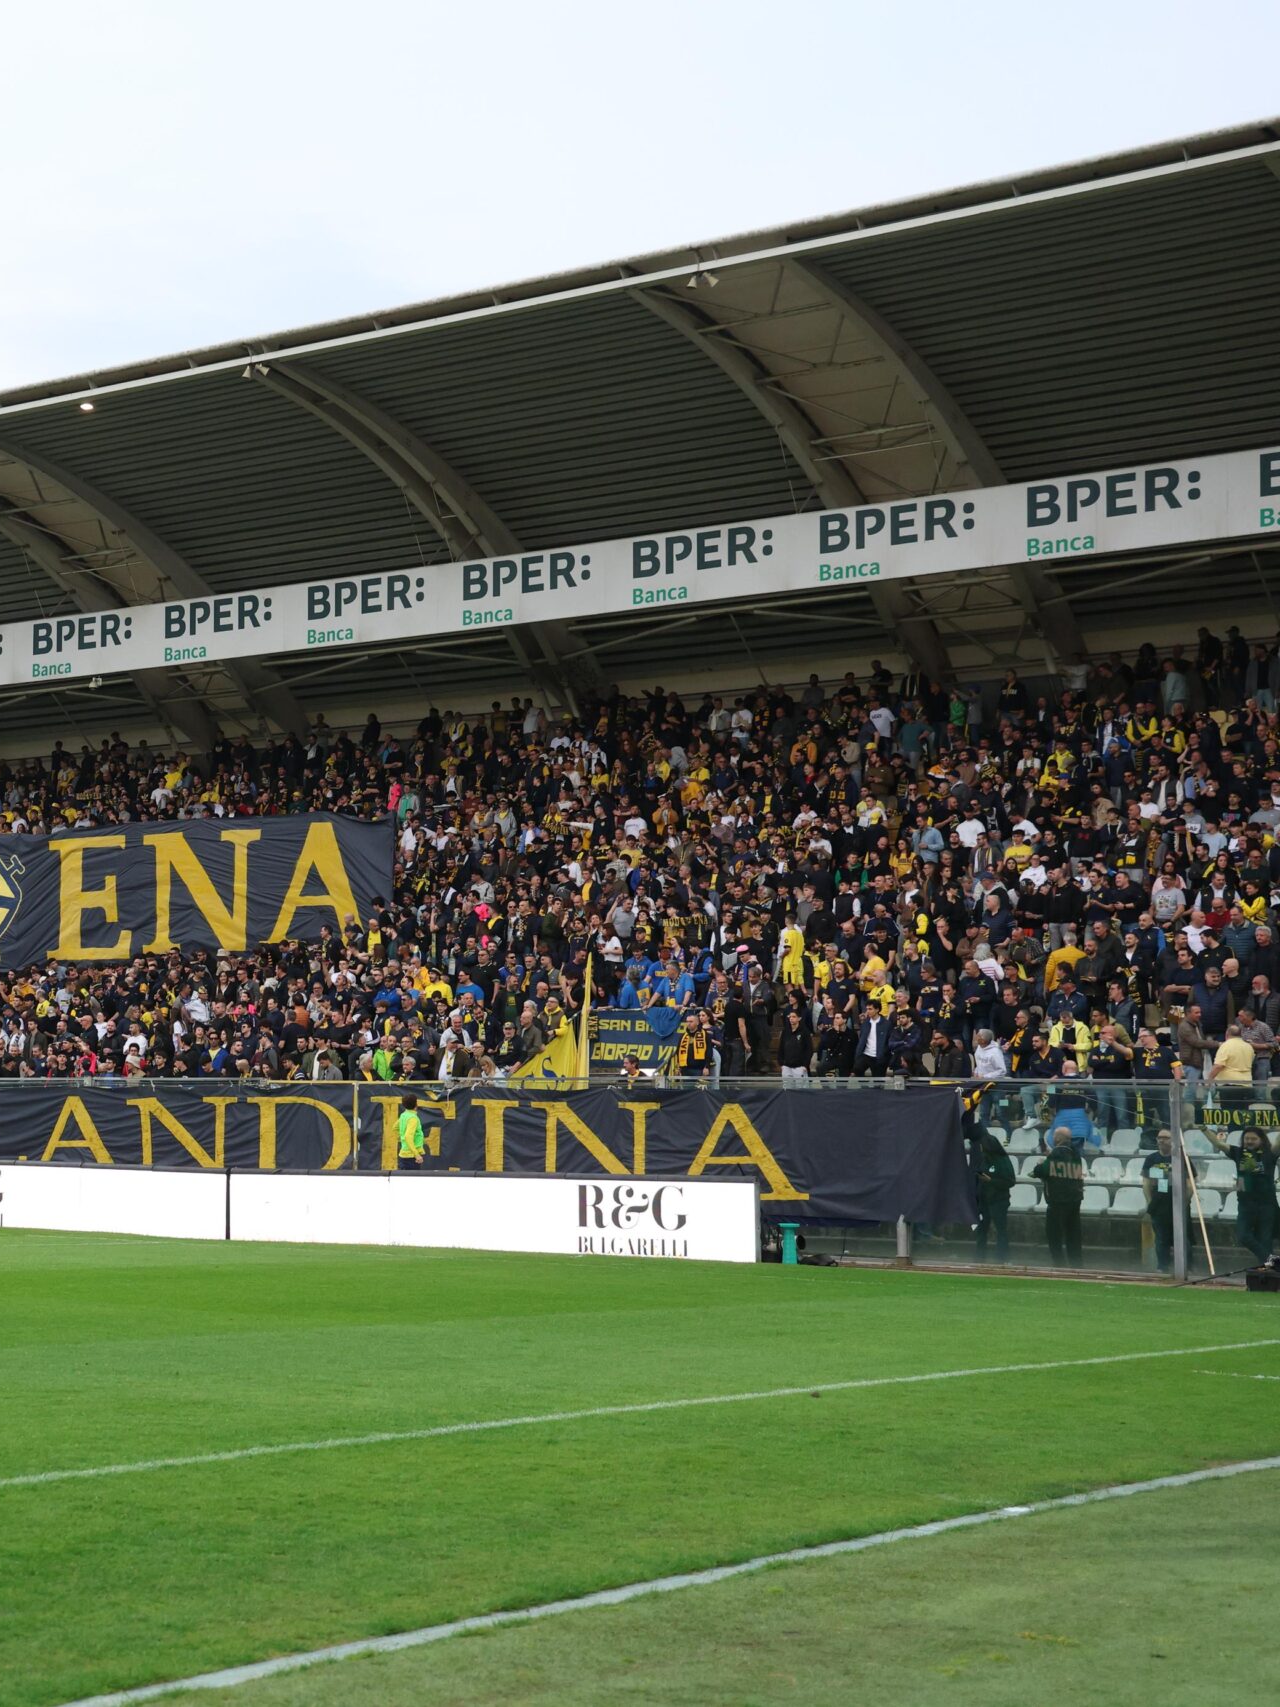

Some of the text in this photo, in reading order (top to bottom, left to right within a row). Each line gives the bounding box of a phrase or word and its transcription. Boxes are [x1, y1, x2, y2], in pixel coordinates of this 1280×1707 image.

[1027, 534, 1094, 557] Banca
[820, 562, 880, 581] Banca
[633, 586, 687, 605] Banca
[463, 608, 512, 626] Banca
[308, 627, 353, 644] Banca
[165, 645, 206, 662] Banca
[33, 661, 71, 678] Banca
[599, 1019, 631, 1032] SAN
[591, 1042, 653, 1061] GIORGIO
[1203, 1109, 1280, 1126] MOD ENA
[577, 1184, 688, 1231] R&G
[578, 1236, 688, 1257] BULGARELLI
